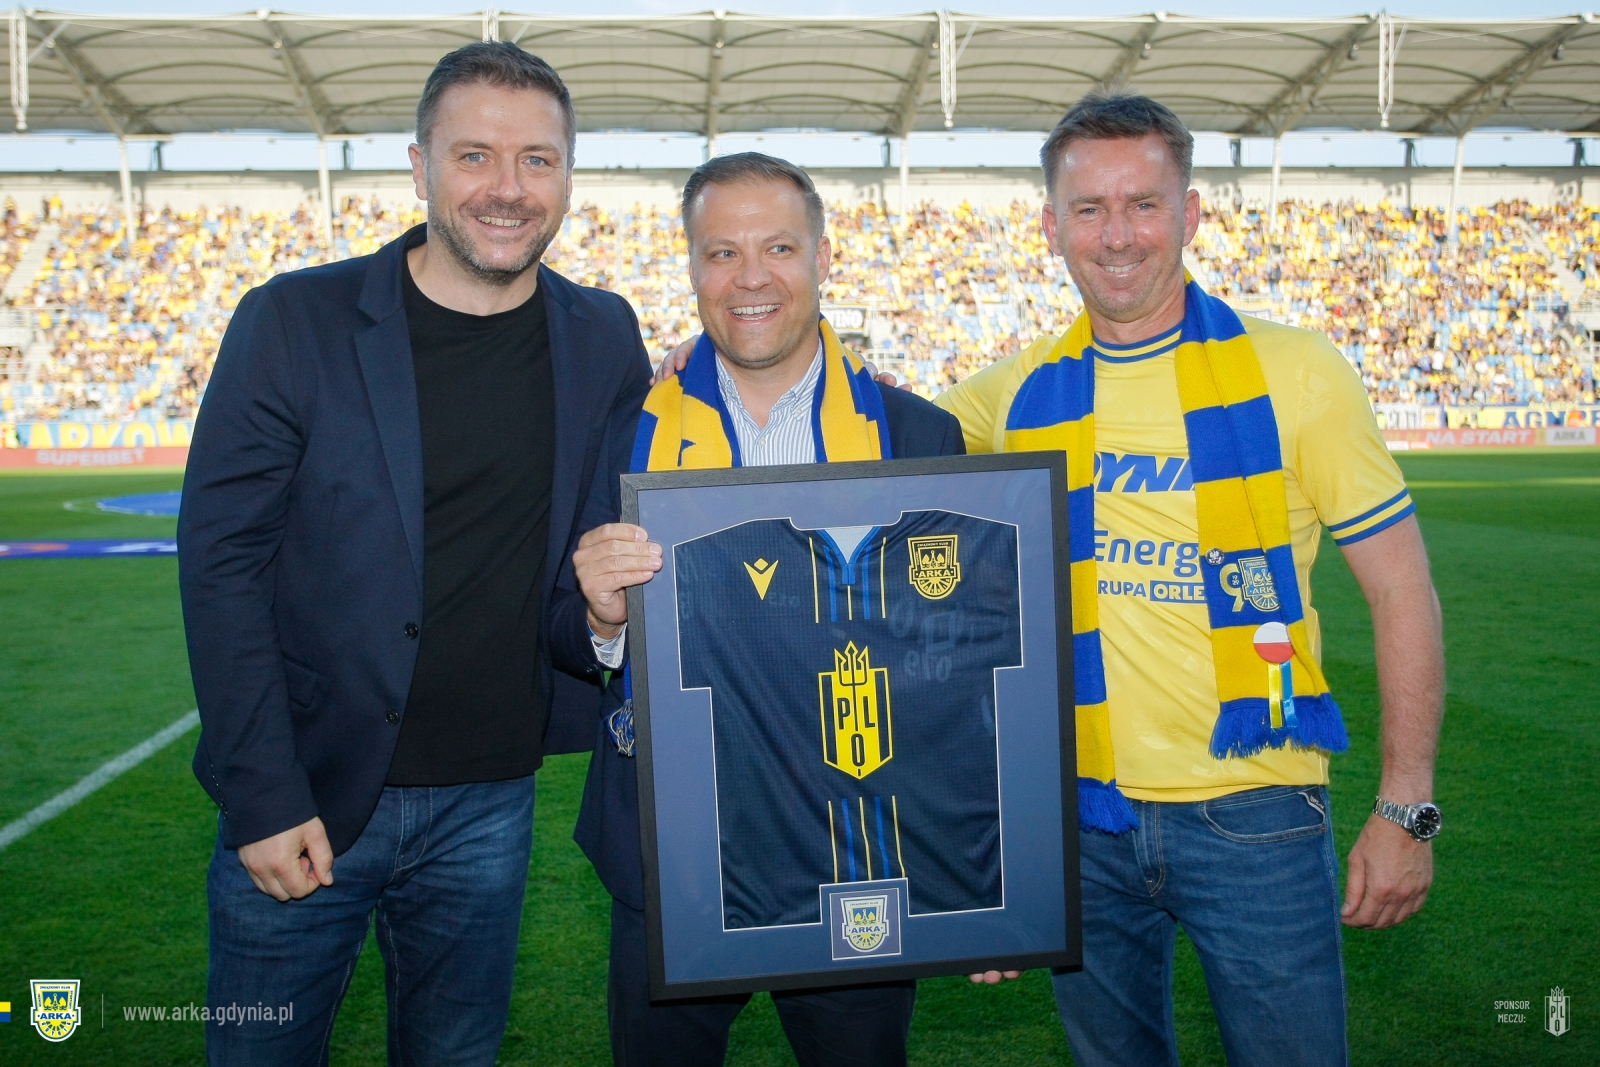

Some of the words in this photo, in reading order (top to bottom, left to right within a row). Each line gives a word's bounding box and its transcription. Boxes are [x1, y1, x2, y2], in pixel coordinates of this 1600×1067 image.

[1425, 430, 1456, 445] NA
[1461, 430, 1532, 445] START
[1554, 430, 1586, 441] ARKA
[35, 447, 146, 467] SUPERBET
[918, 569, 951, 578] ARKA
[851, 925, 881, 933] ARKA
